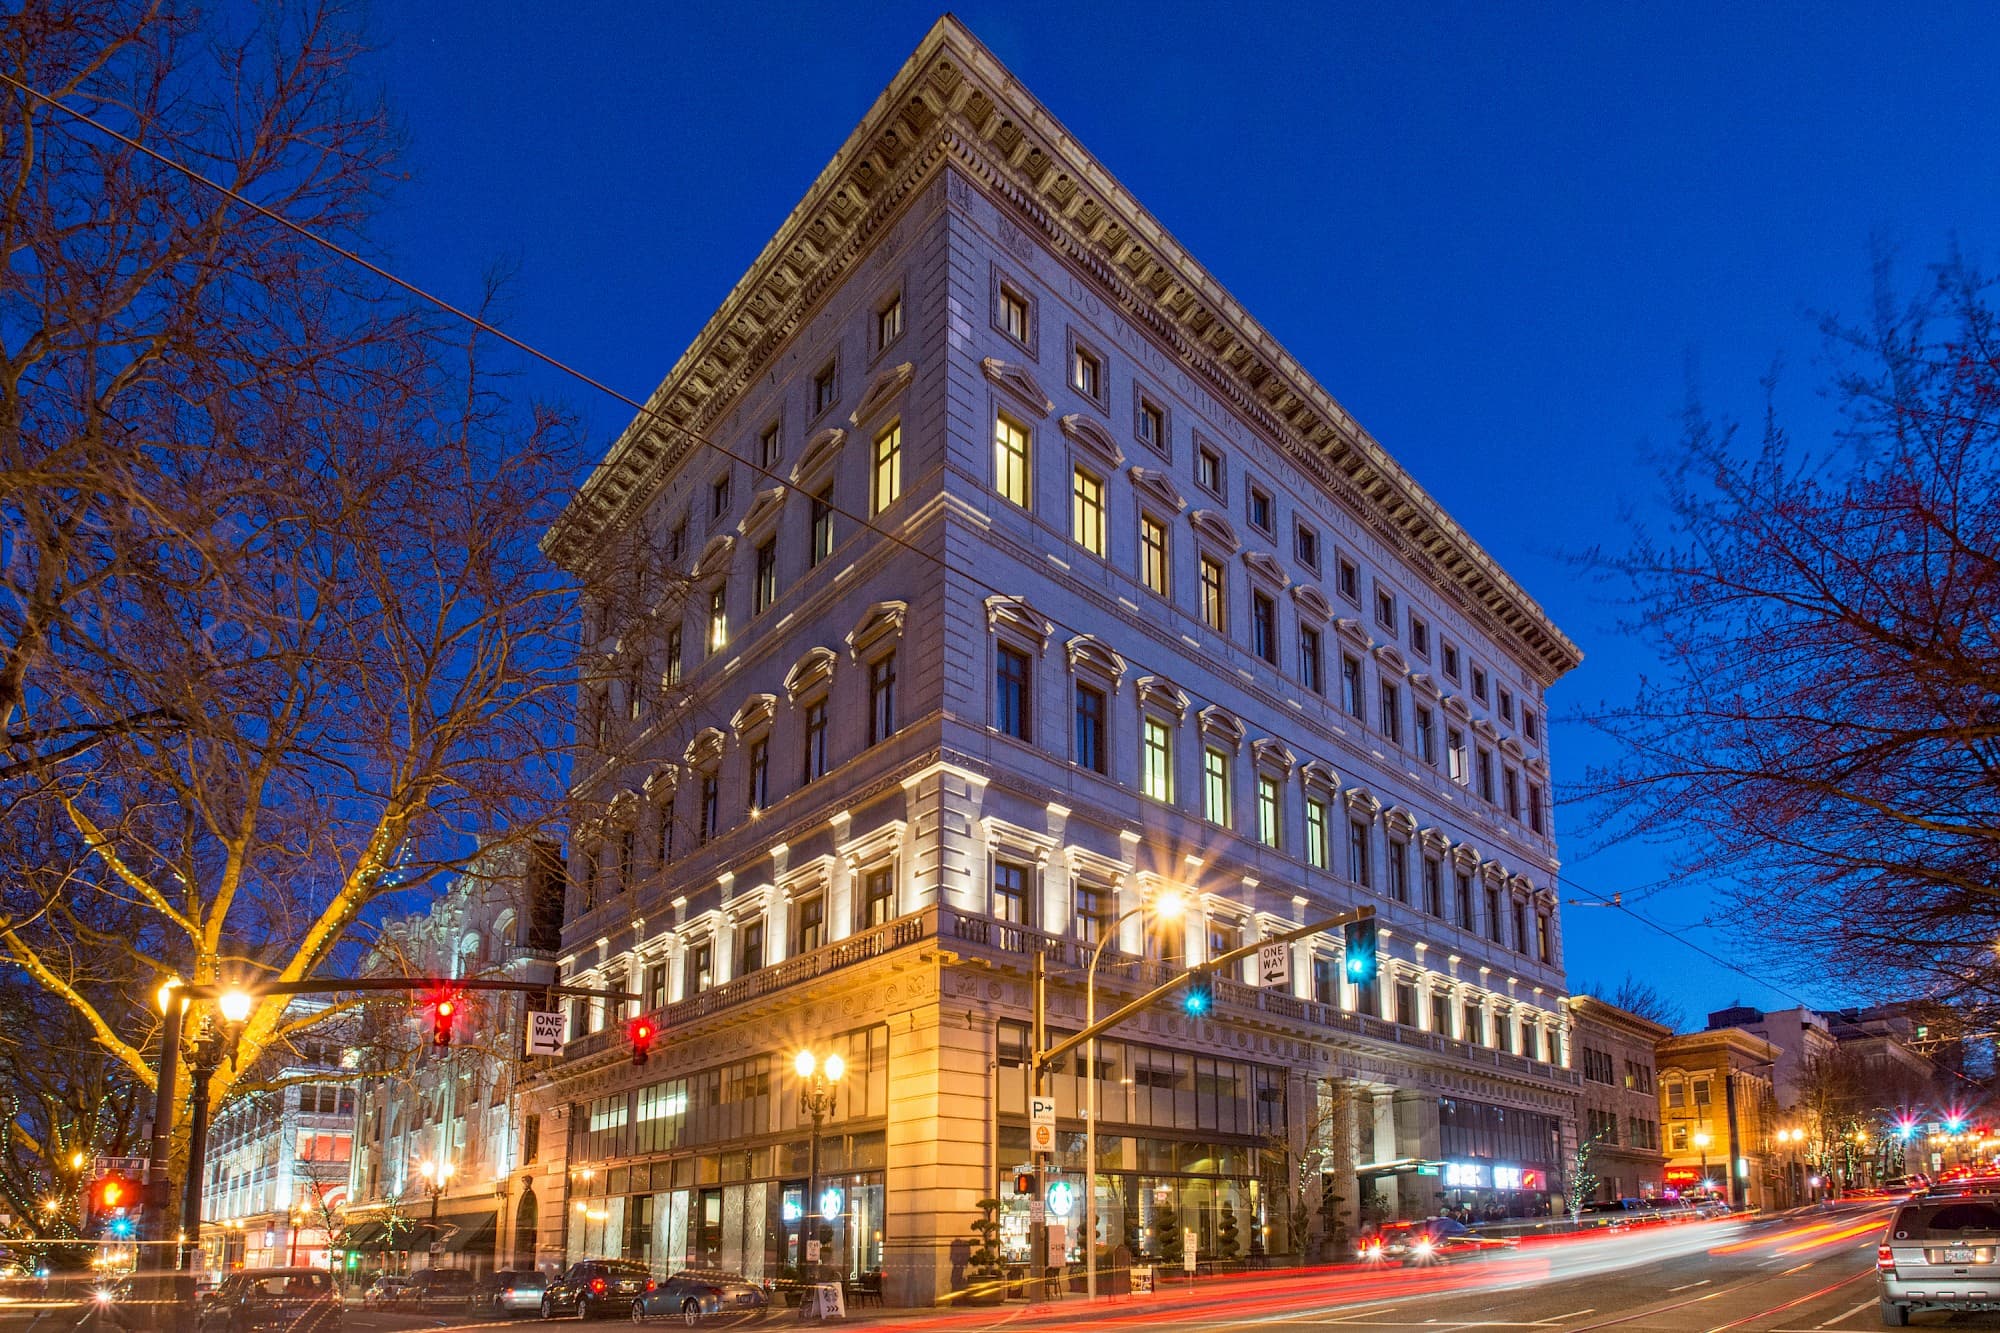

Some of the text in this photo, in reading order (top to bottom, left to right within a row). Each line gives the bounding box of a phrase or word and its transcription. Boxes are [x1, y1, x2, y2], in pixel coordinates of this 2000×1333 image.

[1263, 945, 1284, 959] ONE
[1263, 956, 1285, 969] WAY
[535, 1015, 562, 1026] ONE
[535, 1026, 562, 1037] WAY
[1033, 1101, 1044, 1119] P
[97, 1159, 108, 1168] SW
